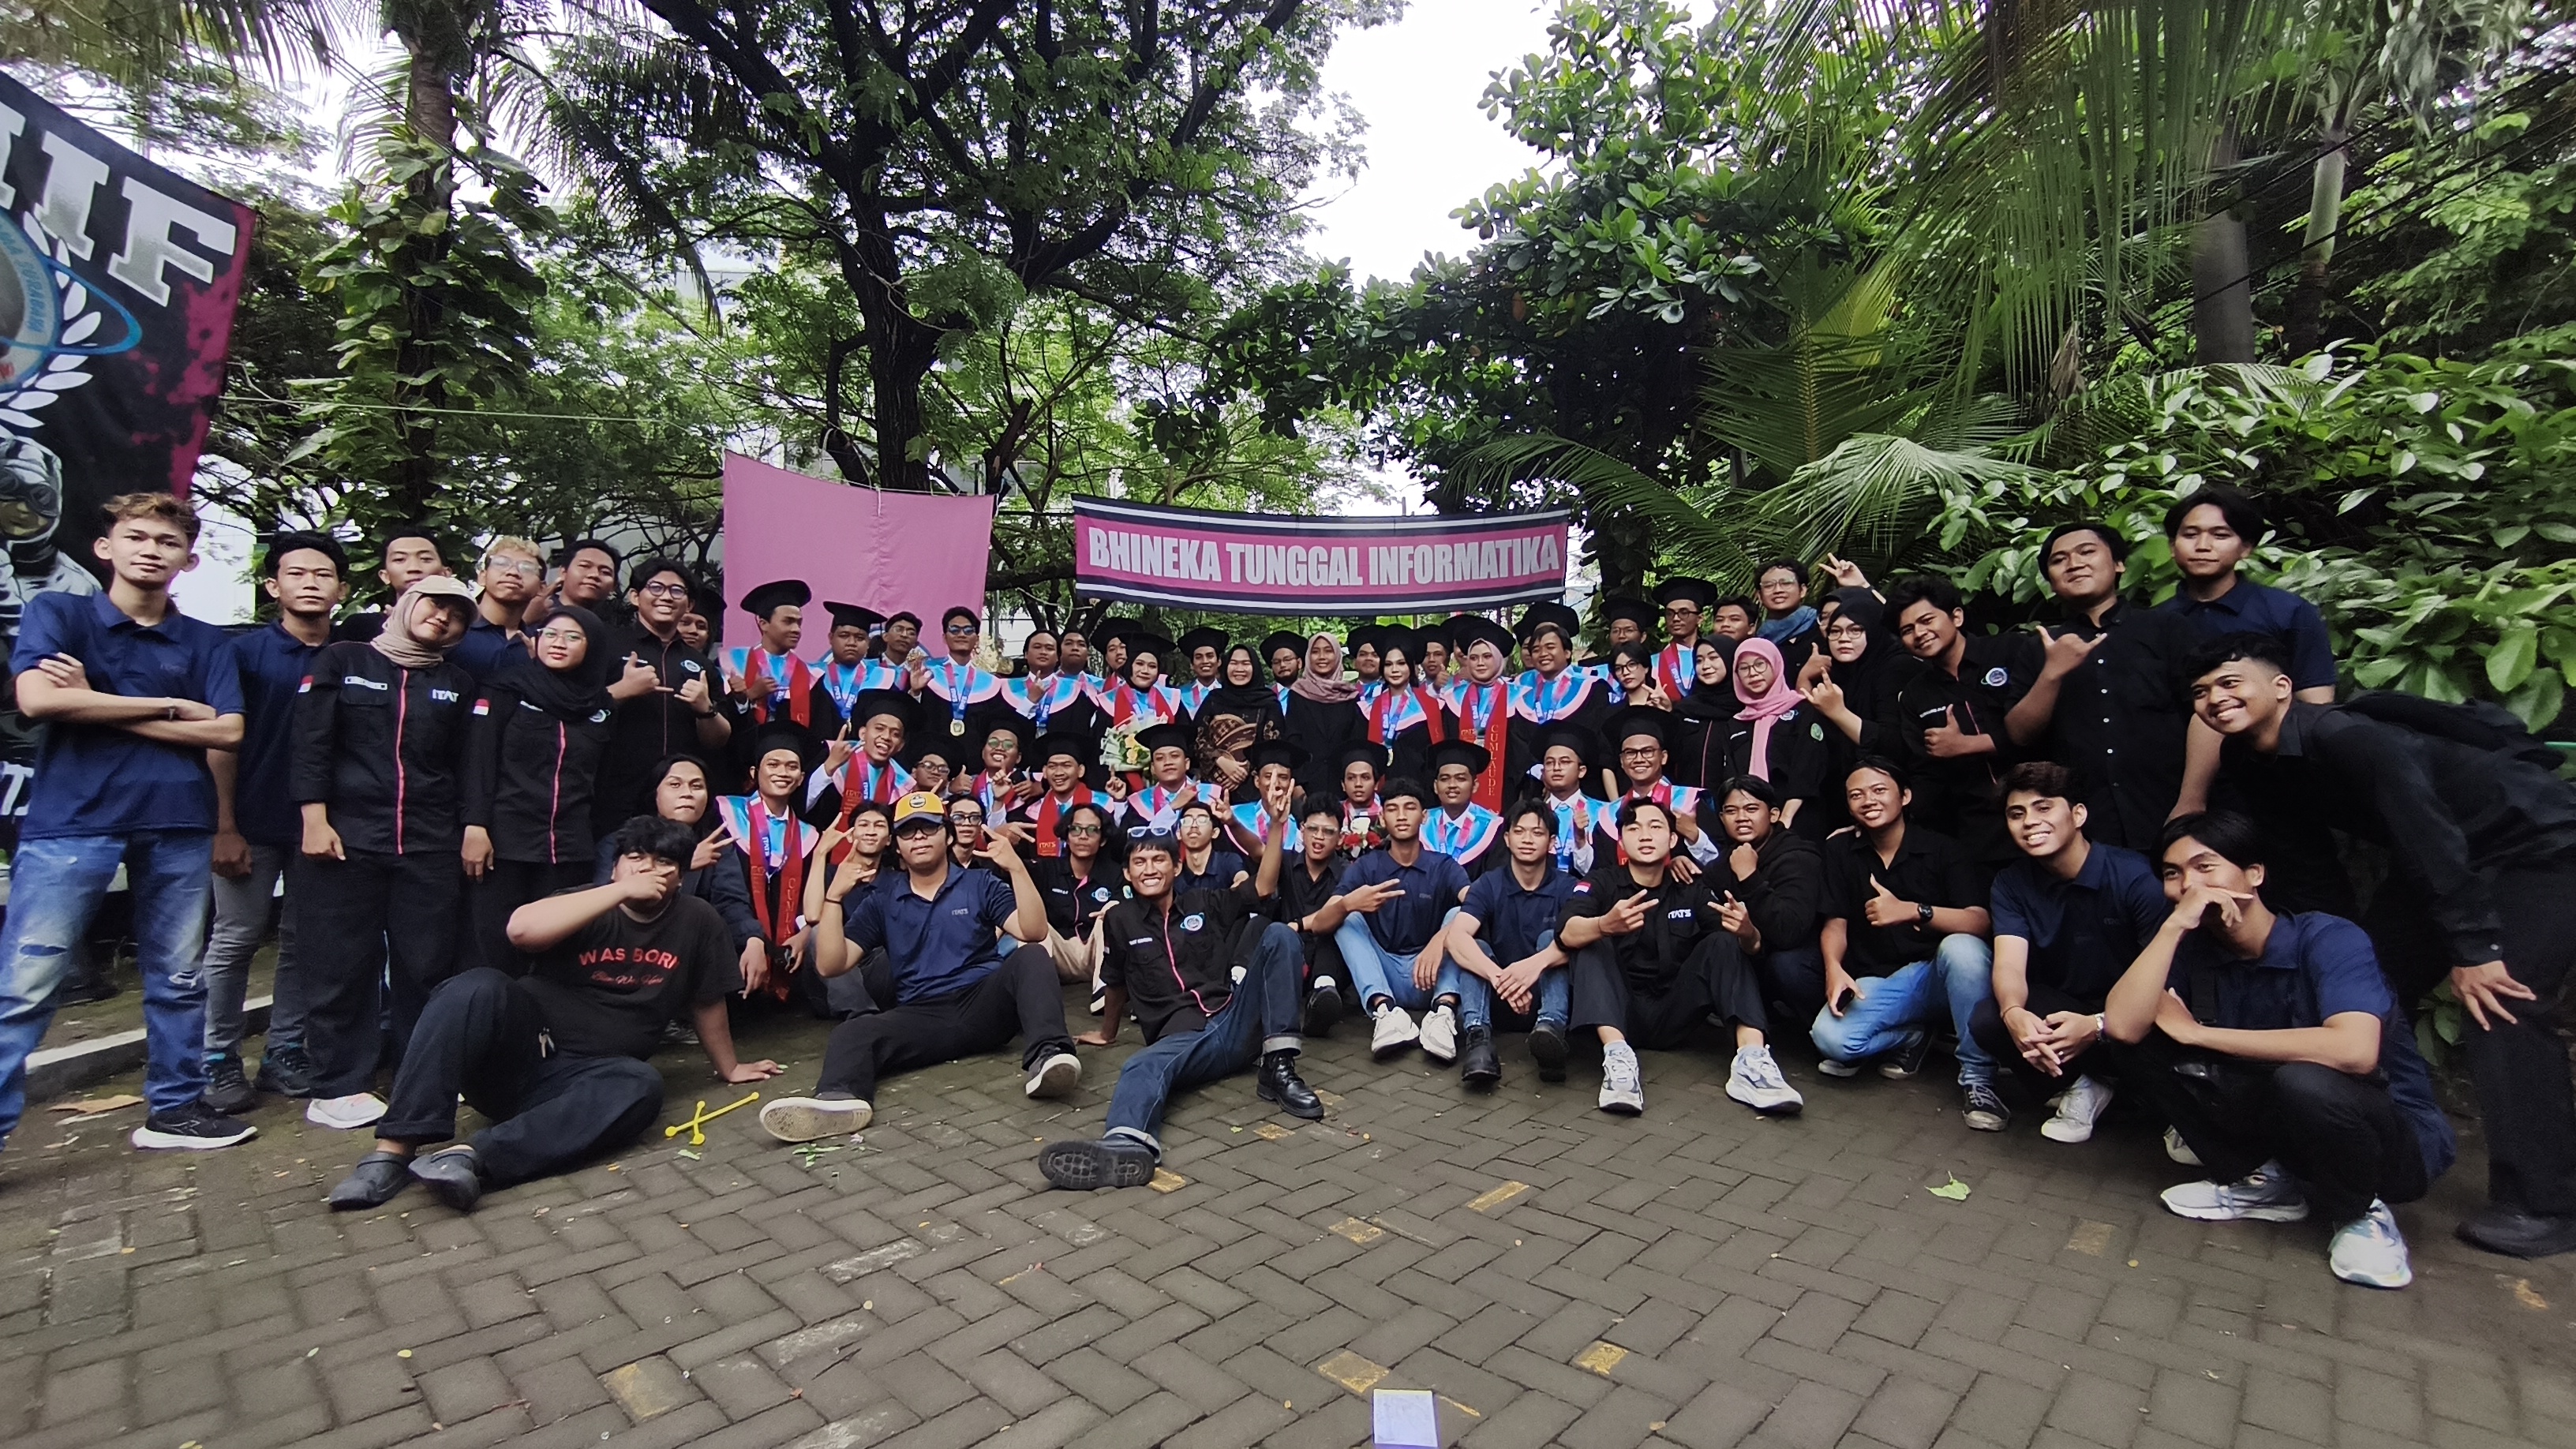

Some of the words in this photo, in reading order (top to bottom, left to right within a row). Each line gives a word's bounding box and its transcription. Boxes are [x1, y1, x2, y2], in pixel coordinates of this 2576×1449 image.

[1088, 526, 1222, 582] BHINEKA
[1226, 542, 1363, 586] TUNGGAL
[1368, 534, 1560, 586] INFORMATIKA
[432, 688, 459, 702] ITAT
[1488, 724, 1499, 796] CUMLAUDE
[1668, 908, 1692, 919] ITATS
[578, 947, 627, 966] WAS
